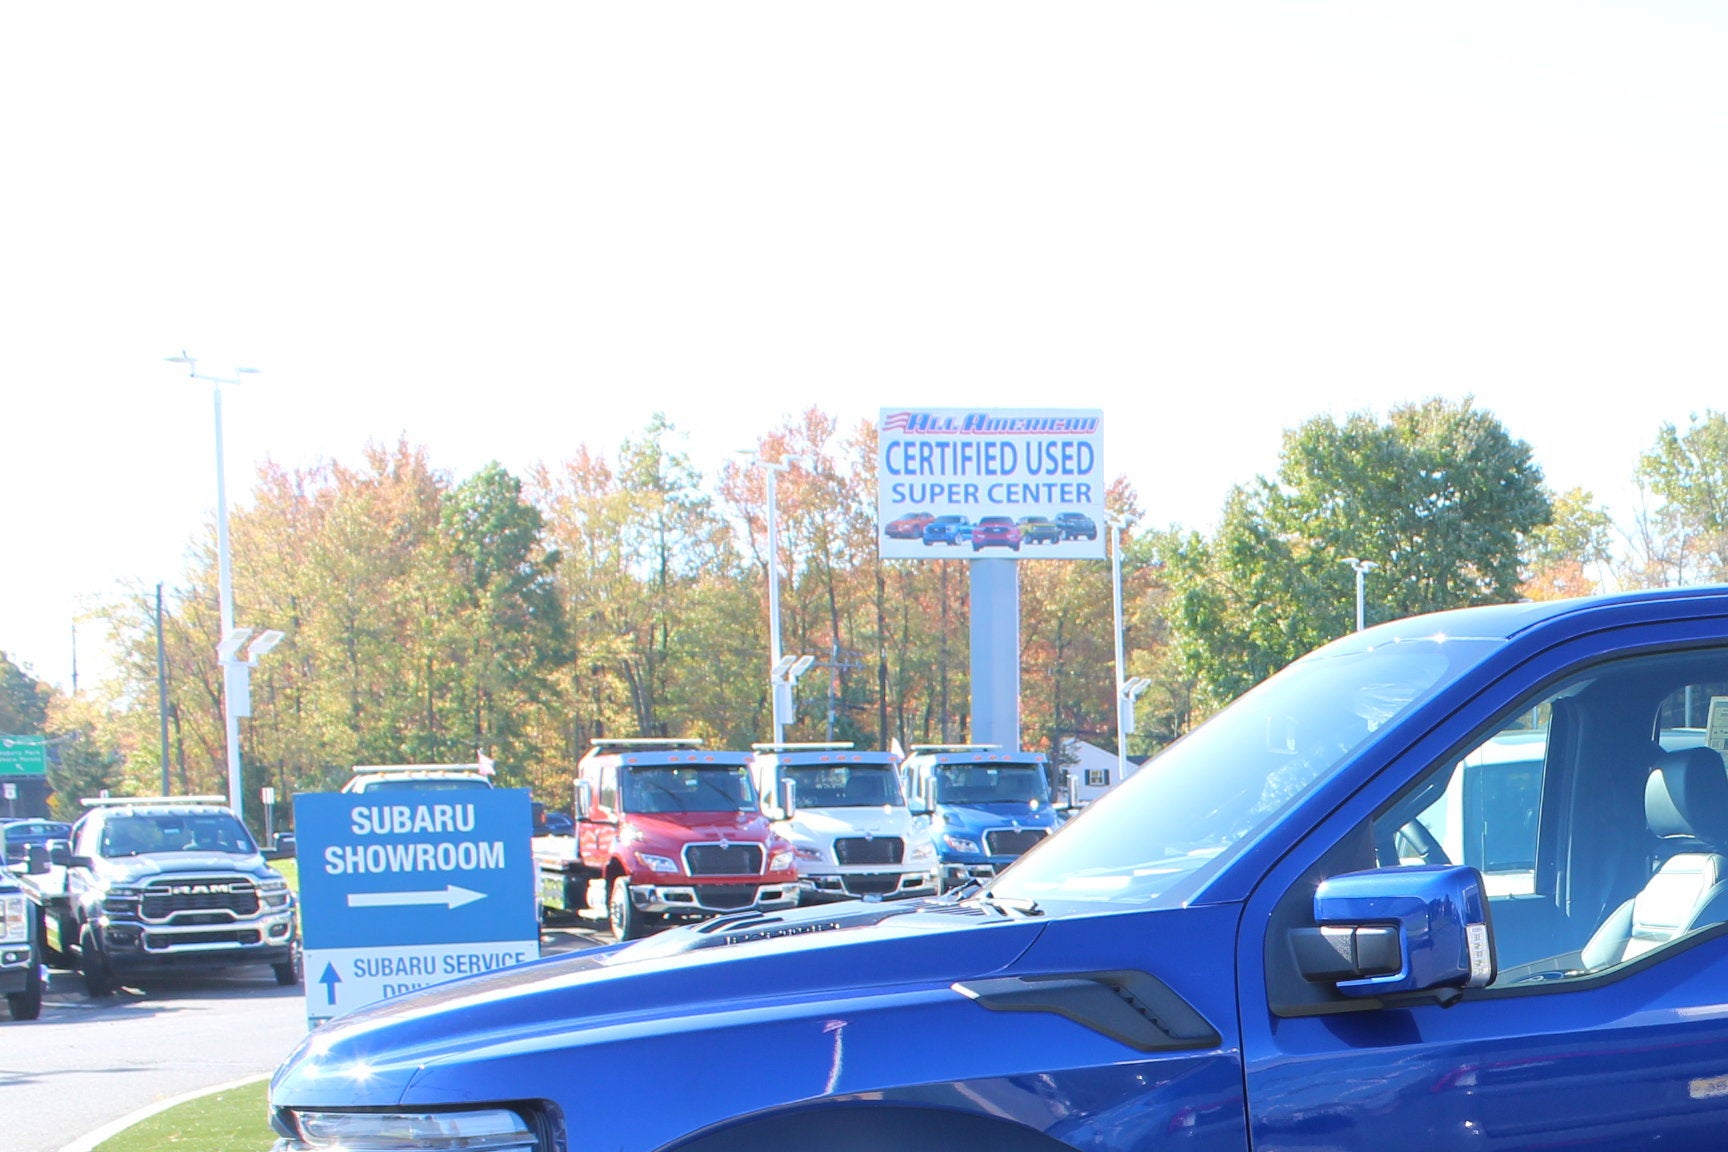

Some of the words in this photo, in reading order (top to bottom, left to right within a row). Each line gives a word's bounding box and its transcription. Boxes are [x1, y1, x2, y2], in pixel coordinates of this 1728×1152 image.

[885, 440, 1018, 476] CERTIFIED
[1026, 440, 1095, 476] USED
[891, 483, 980, 504] SUPER
[987, 482, 1093, 504] CENTER
[351, 804, 475, 835] SUBARU
[324, 841, 505, 875] SHOWROOM
[173, 884, 229, 894] RAM
[353, 956, 437, 978] SUBARU
[443, 952, 526, 974] SERVICE
